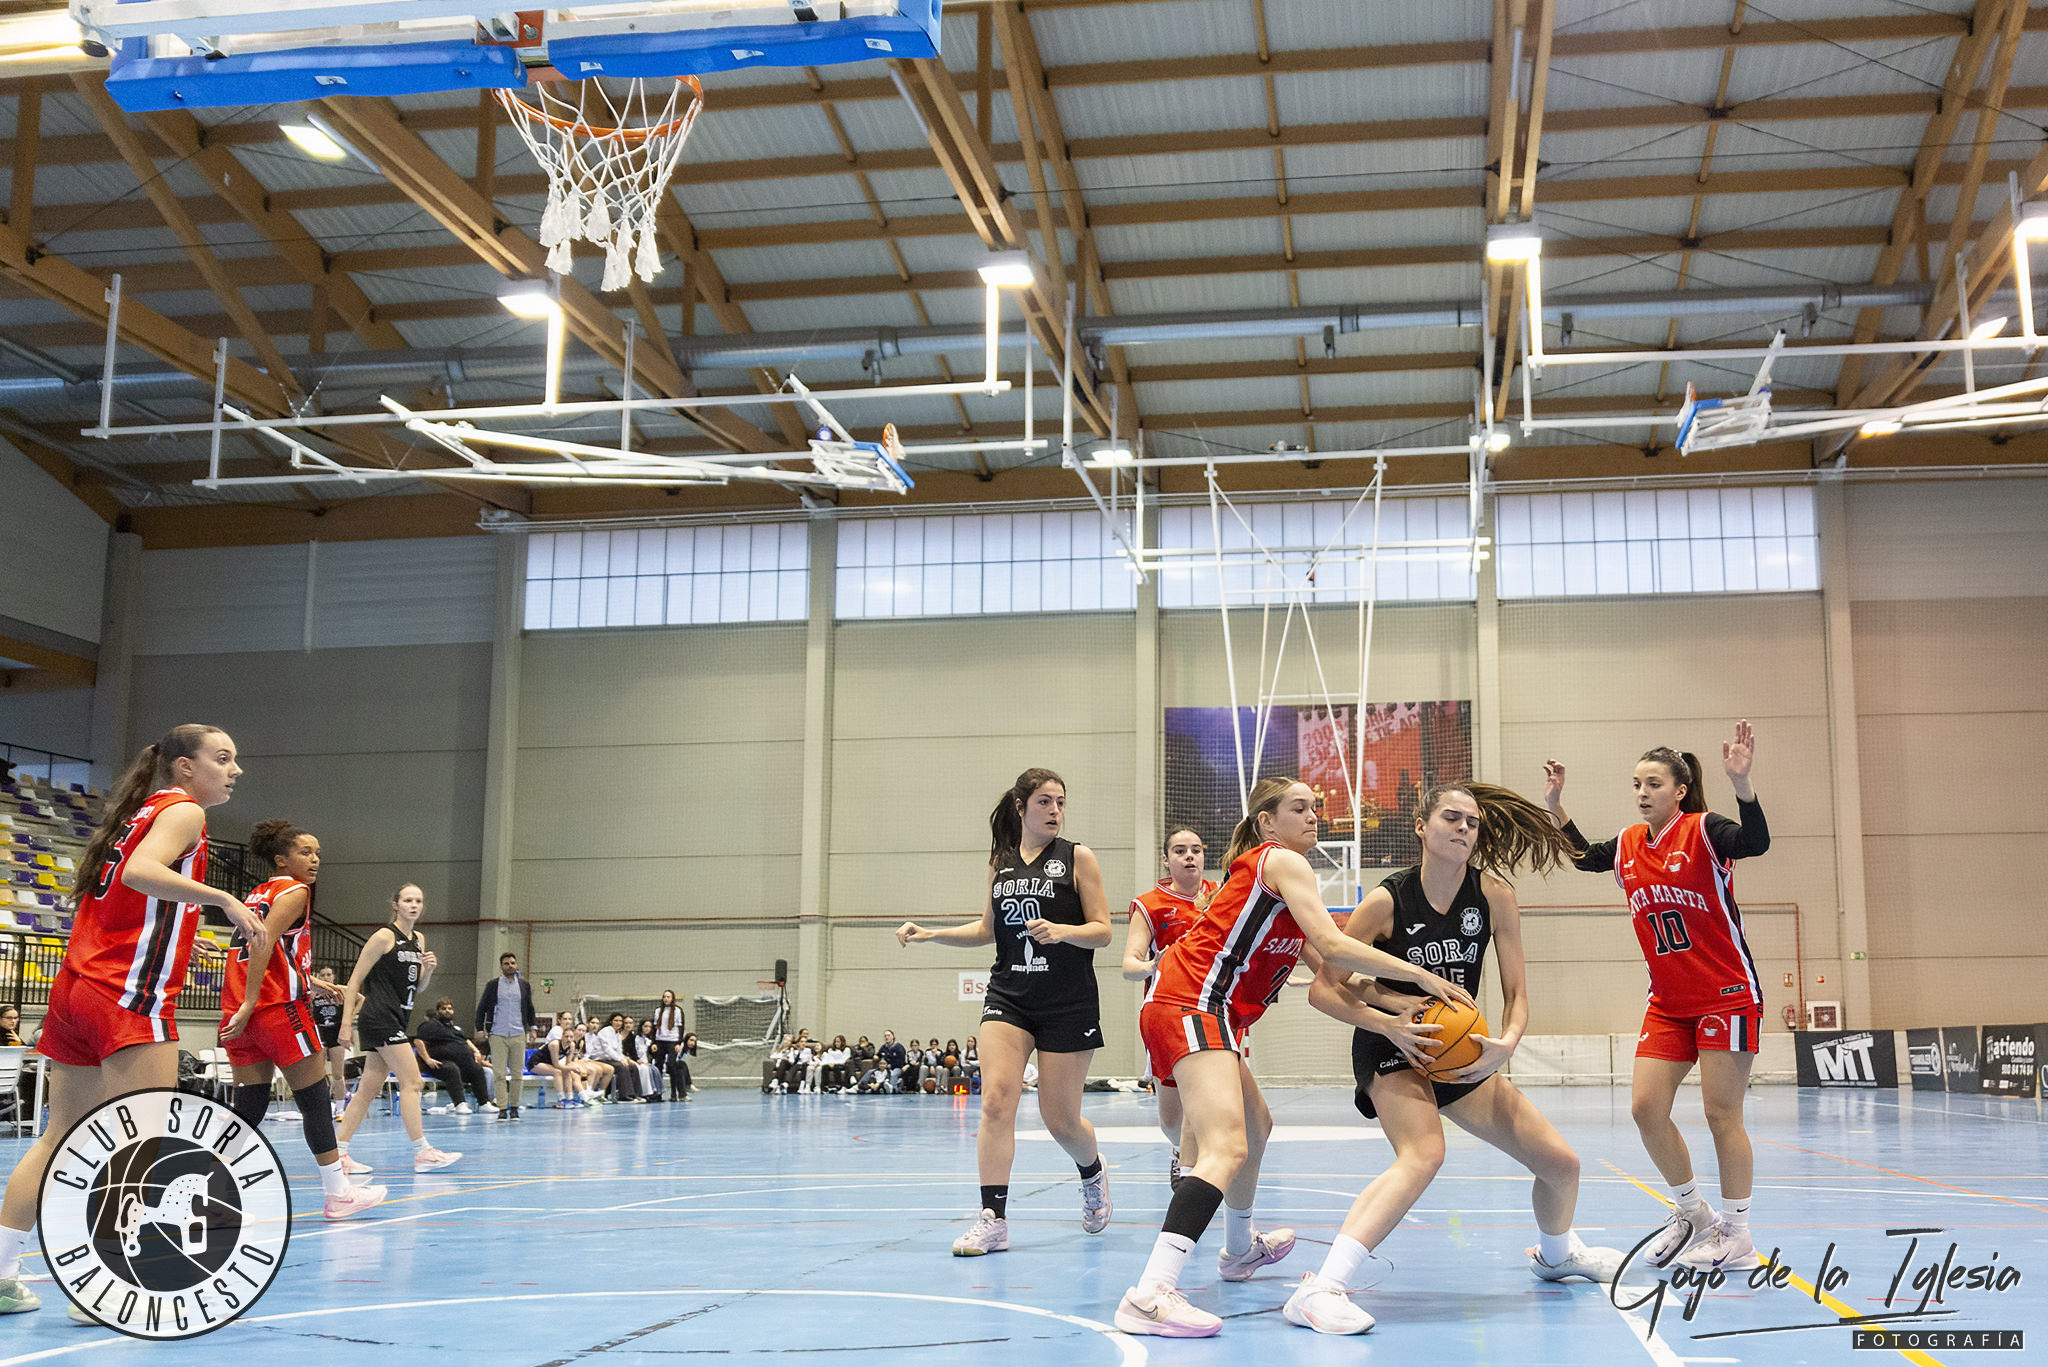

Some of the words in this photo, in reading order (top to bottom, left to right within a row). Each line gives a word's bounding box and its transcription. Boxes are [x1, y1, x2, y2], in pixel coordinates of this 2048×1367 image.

[993, 877, 1056, 898] SORIA
[1649, 884, 1710, 912] MARTA
[1001, 897, 1041, 926] 20
[1646, 909, 1693, 956] 10
[1812, 1037, 1876, 1080] MT
